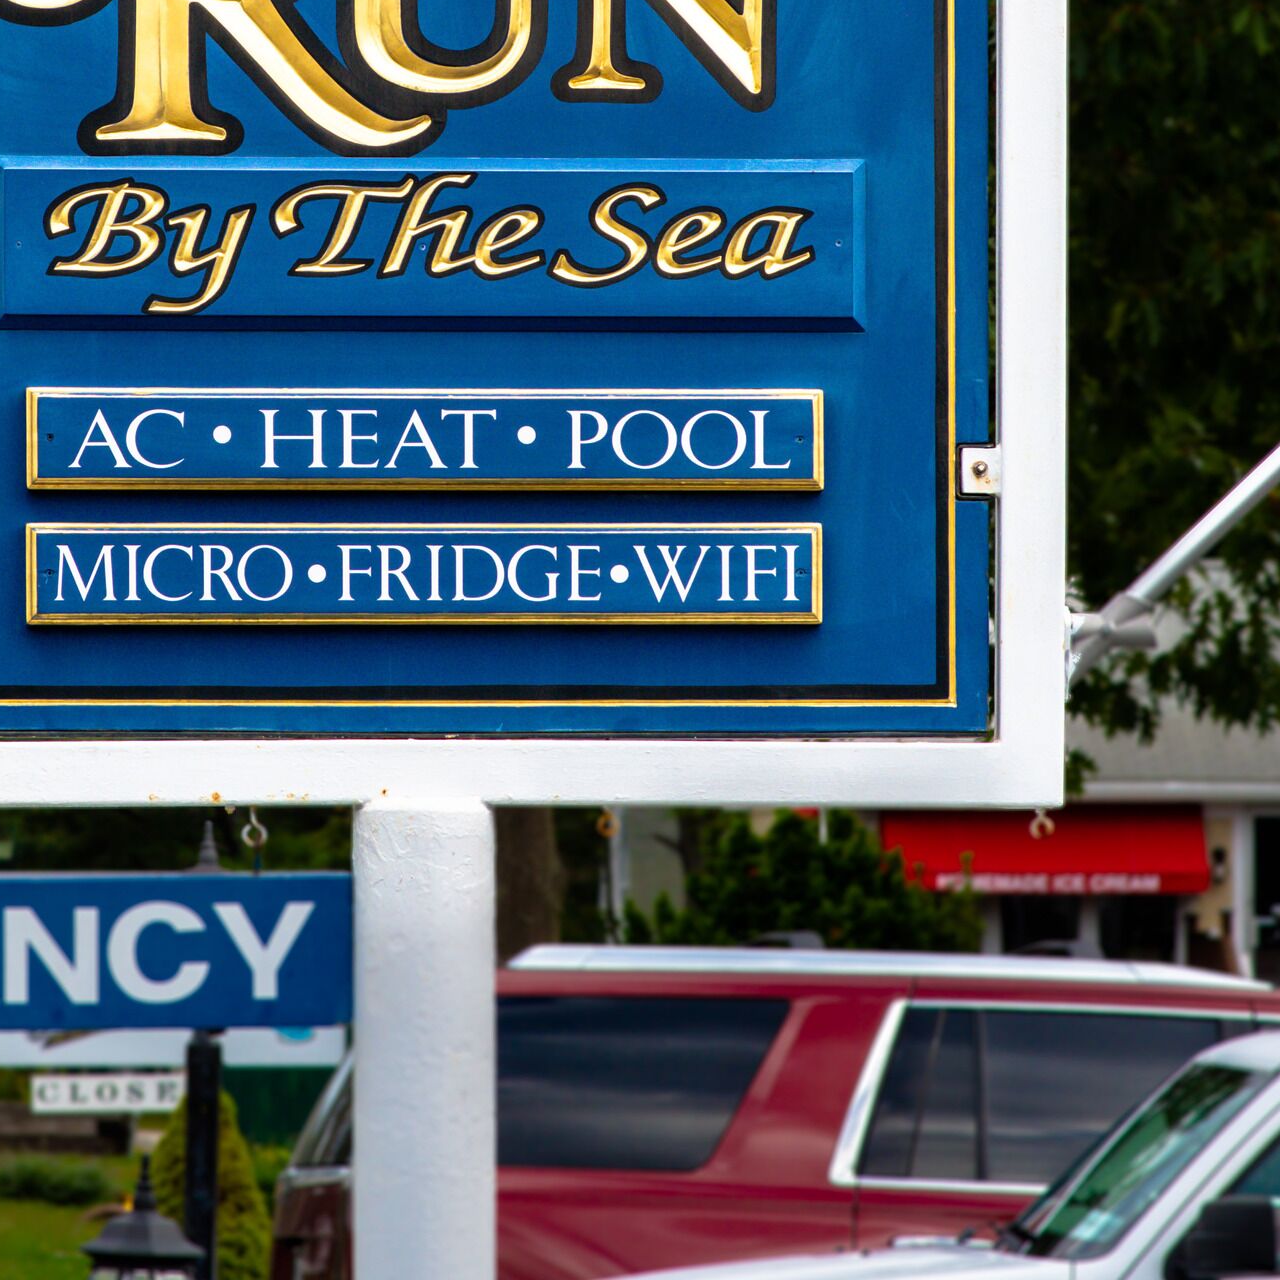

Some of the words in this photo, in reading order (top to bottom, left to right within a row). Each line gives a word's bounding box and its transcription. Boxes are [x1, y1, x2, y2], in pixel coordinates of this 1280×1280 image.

[49, 181, 252, 313] By
[274, 174, 542, 276] The
[552, 187, 812, 283] Sea
[68, 408, 186, 469] AC
[258, 408, 498, 469] HEAT
[566, 409, 791, 470] POOL
[54, 544, 293, 602] MICRO
[337, 544, 602, 602] FRIDGE
[632, 544, 800, 603] WIFI
[1052, 872, 1085, 893] ICE
[1090, 872, 1161, 893] CREAM
